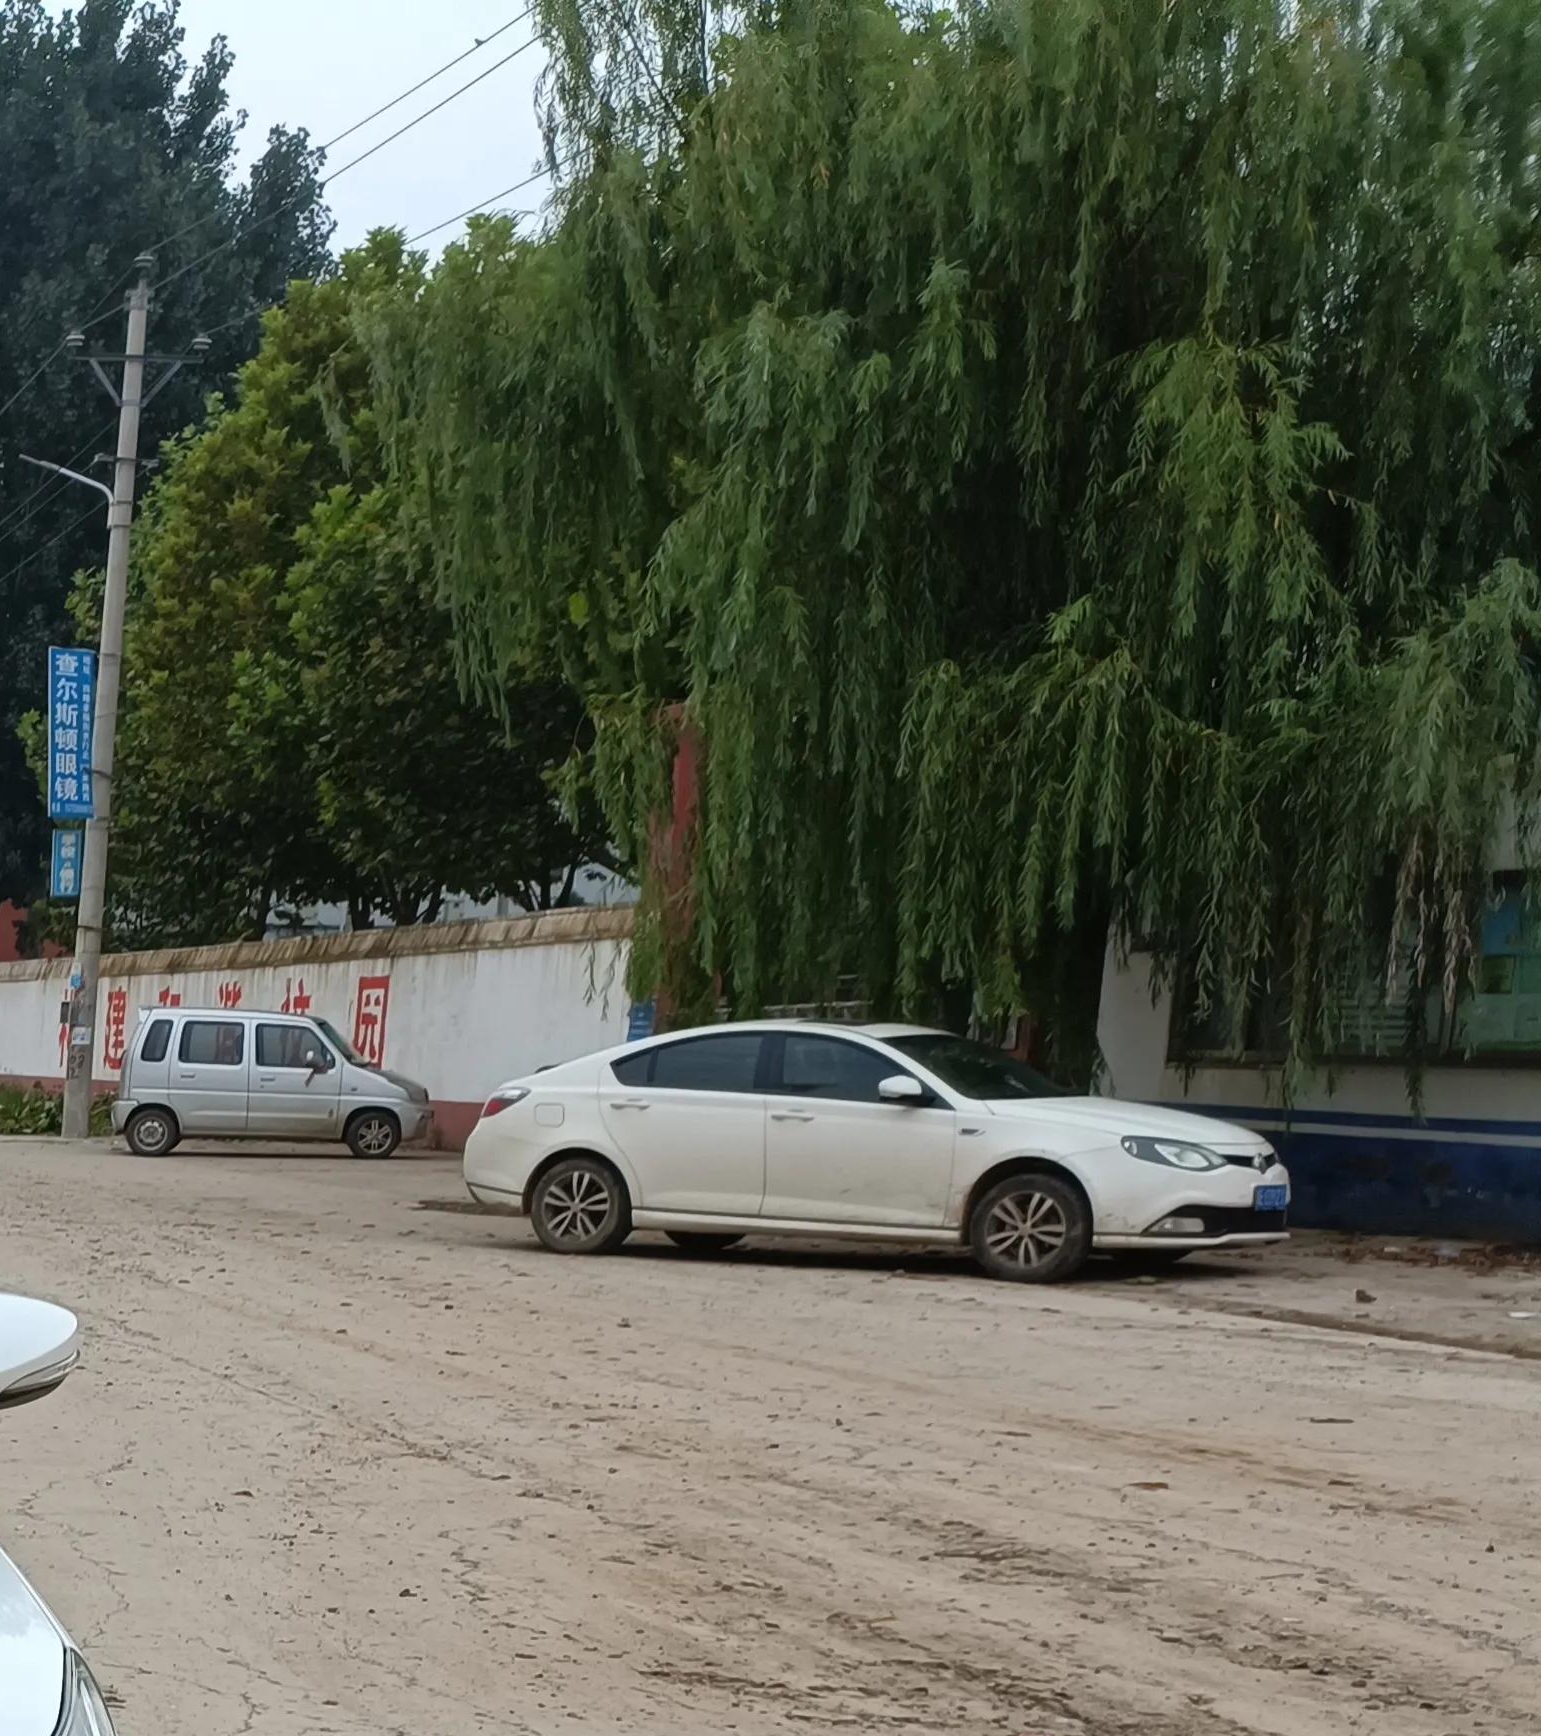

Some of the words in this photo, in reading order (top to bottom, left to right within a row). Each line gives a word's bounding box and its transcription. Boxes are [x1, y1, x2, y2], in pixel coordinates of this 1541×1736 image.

[54, 653, 79, 801] 查尔斯顿眼镜
